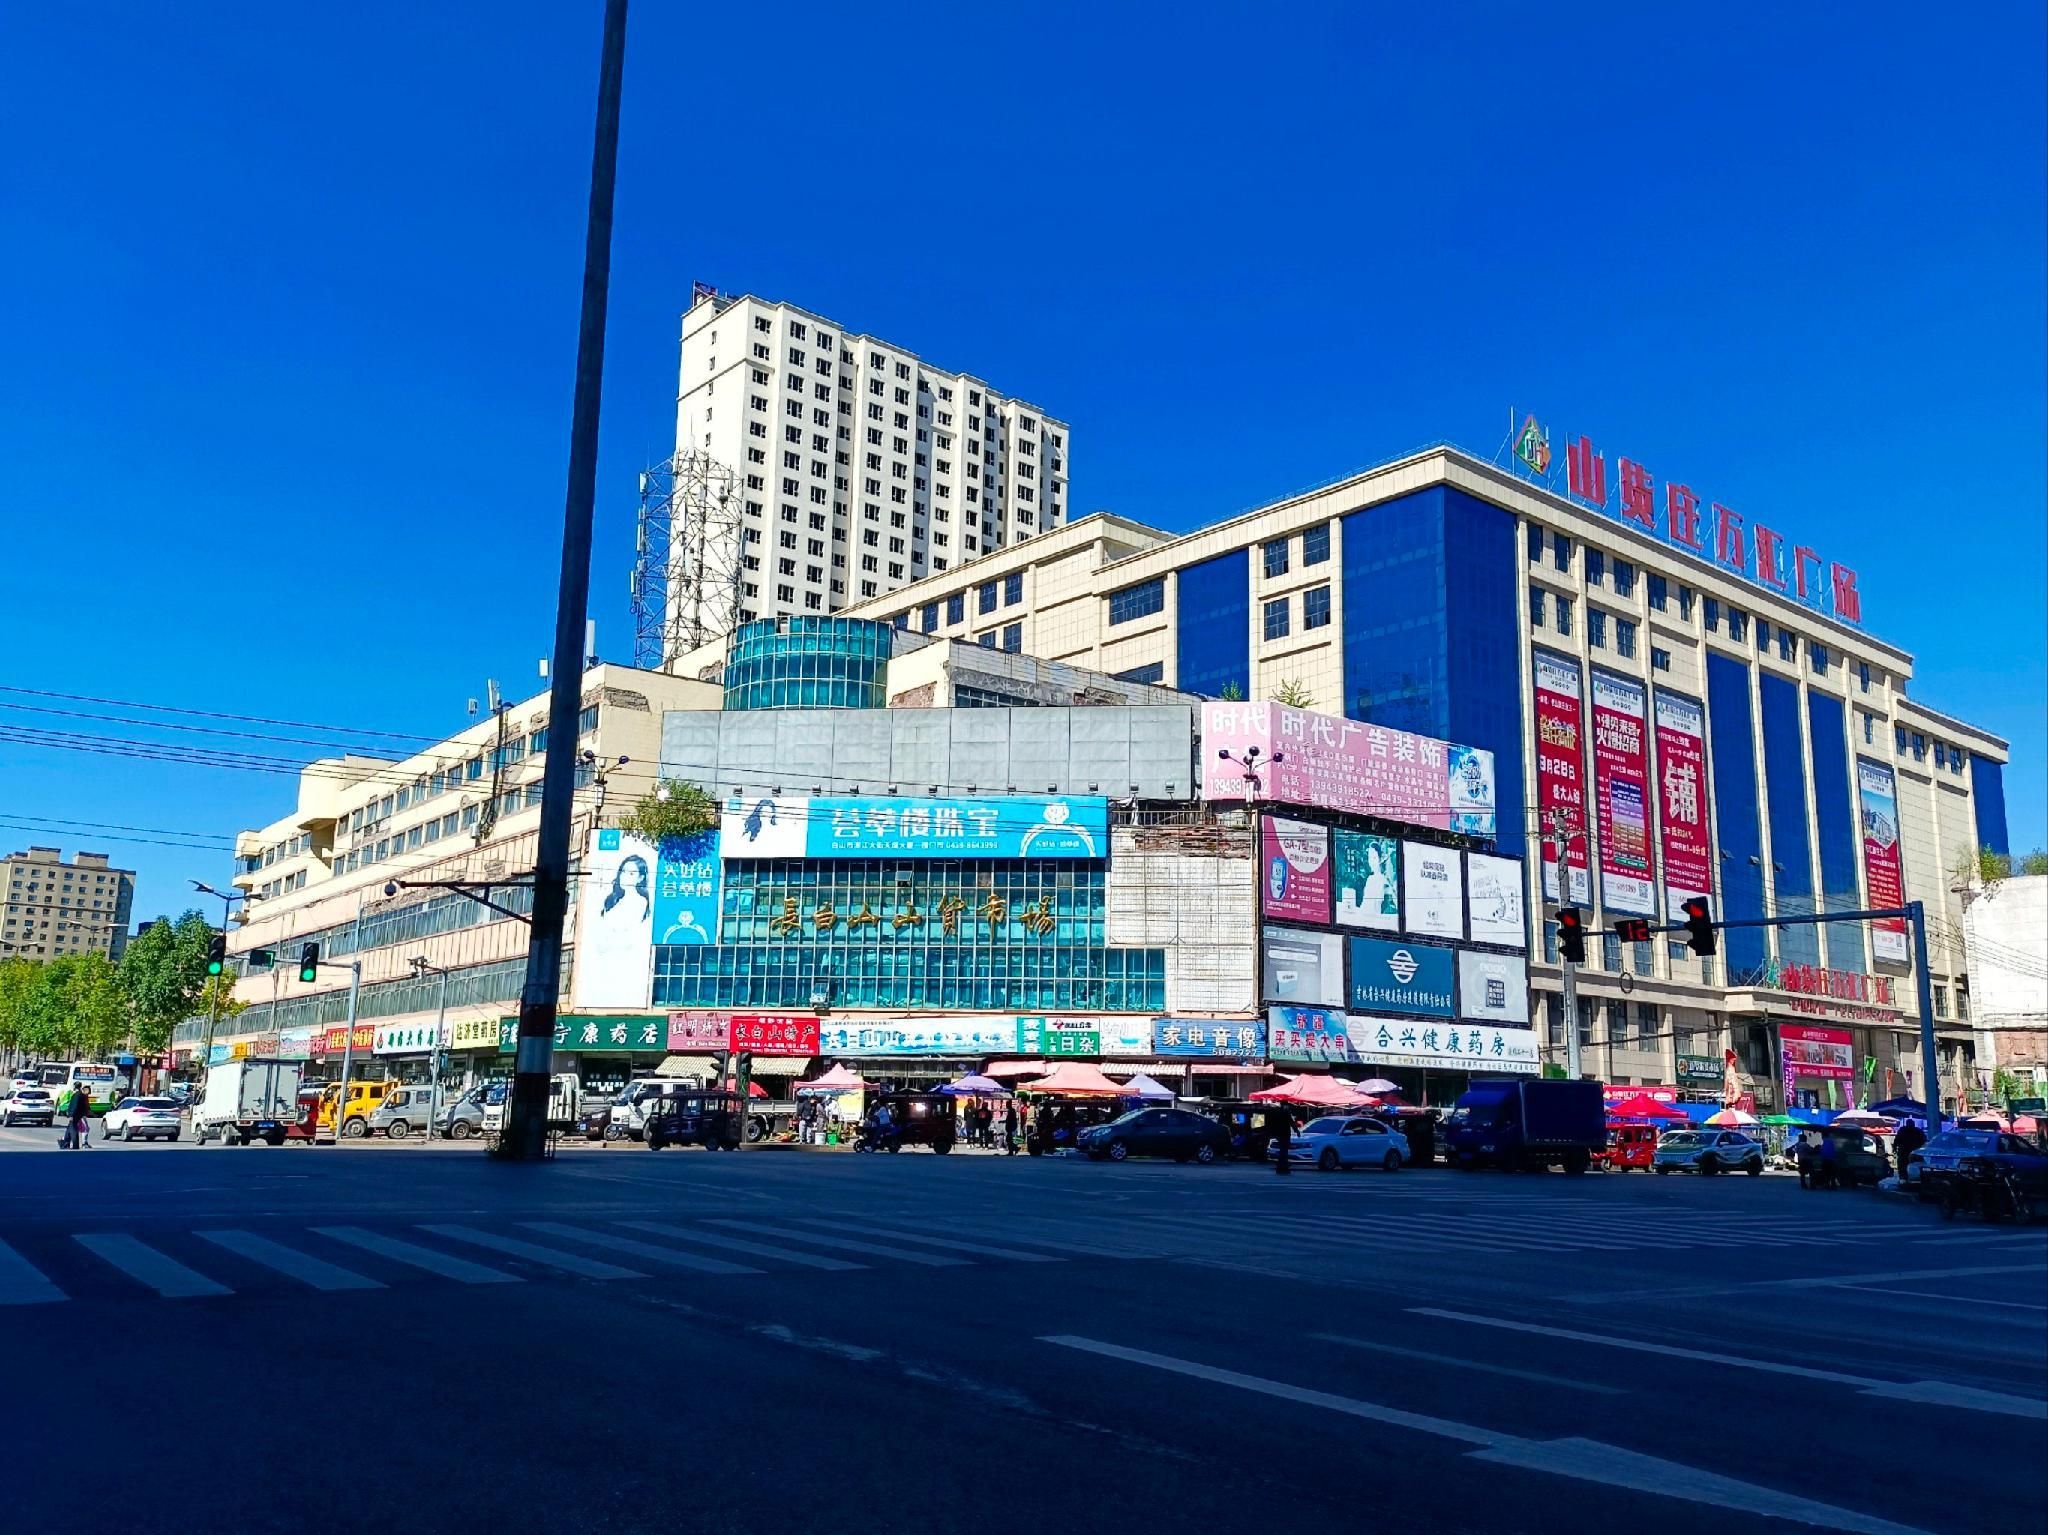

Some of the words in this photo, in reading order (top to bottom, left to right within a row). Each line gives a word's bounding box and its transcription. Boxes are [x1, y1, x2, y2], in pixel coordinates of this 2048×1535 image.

[1567, 435, 1861, 623] 山货庄万汇广场
[1212, 706, 1267, 736] 时代
[1281, 710, 1441, 768] 时代广告装饰
[1664, 757, 1698, 825] 铺
[832, 808, 999, 838] 荟萃楼珠宝
[662, 881, 713, 898] 荟萃楼
[554, 1021, 659, 1045] 宁康药店
[735, 1023, 816, 1044] 长白山特产
[1061, 1036, 1095, 1053] 日杂
[1162, 1025, 1258, 1048] 家电音像
[1275, 1030, 1345, 1051] 买买提大串
[1374, 1024, 1506, 1057] 合兴健康药房
